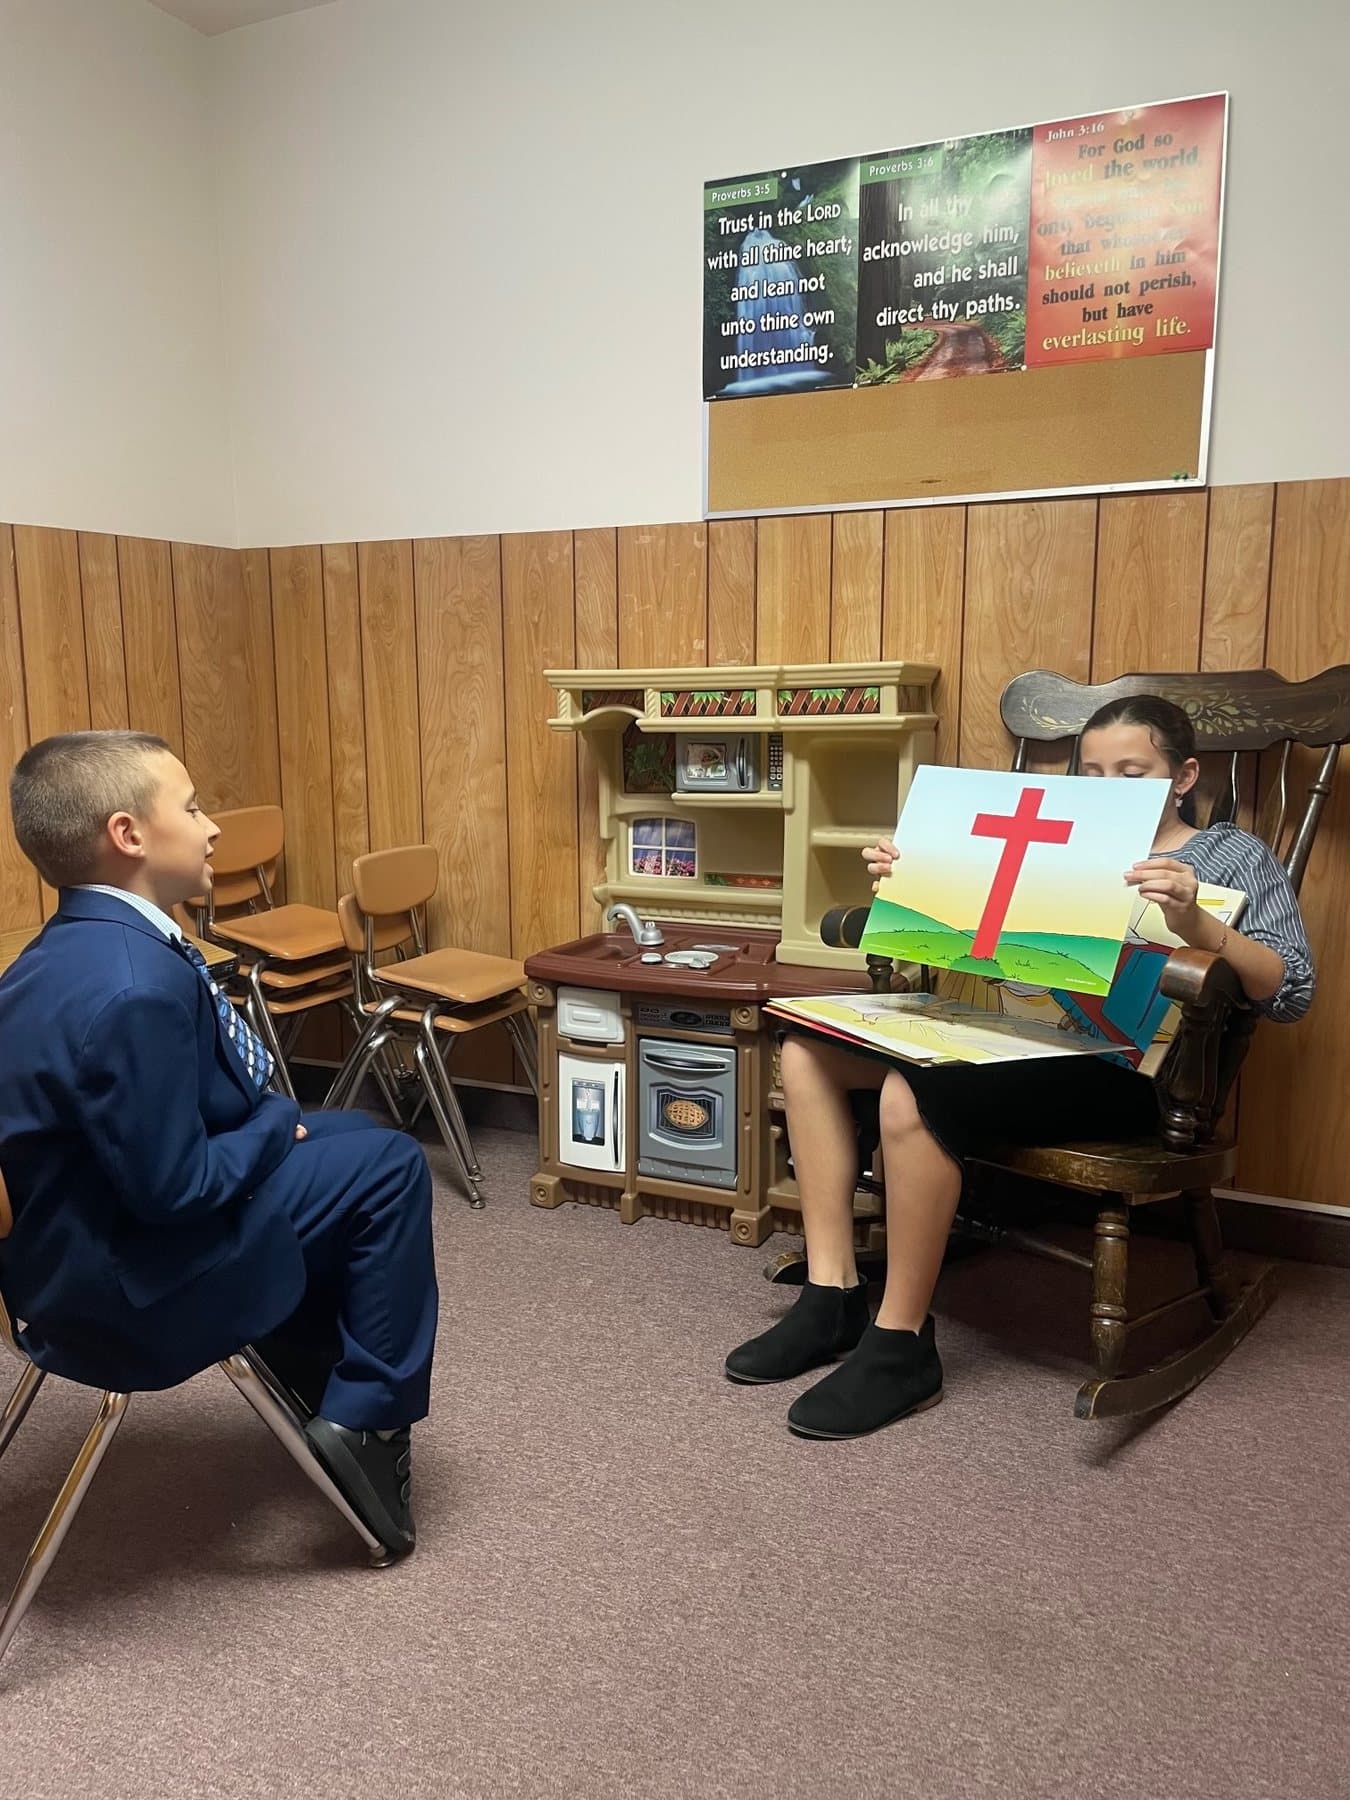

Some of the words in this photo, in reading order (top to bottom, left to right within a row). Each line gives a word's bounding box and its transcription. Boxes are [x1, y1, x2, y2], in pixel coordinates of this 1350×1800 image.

[1045, 128, 1074, 143] John
[1078, 121, 1105, 136] 3:16
[1078, 144, 1105, 160] For
[1113, 134, 1145, 153] God
[1154, 133, 1173, 147] so
[869, 159, 913, 177] Proverbs
[917, 156, 934, 169] 3:6
[1104, 159, 1134, 179] the
[1143, 146, 1199, 170] world
[712, 187, 751, 203] Proverbs
[754, 184, 770, 196] 3:5
[719, 213, 754, 235] Trust
[759, 211, 772, 229] in
[777, 207, 802, 226] the
[898, 203, 912, 222] In
[919, 197, 939, 218] all
[707, 248, 738, 270] with
[741, 246, 758, 266] all
[763, 242, 802, 263] thine
[806, 236, 852, 256] heart;
[863, 230, 974, 262] acknowledge
[983, 223, 1019, 244] him,
[1060, 240, 1090, 256] that
[913, 266, 945, 288] and
[951, 264, 972, 283] he
[978, 256, 1018, 279] shall
[1045, 257, 1121, 281] believeth
[1130, 256, 1146, 270] in
[1155, 250, 1186, 267] him
[730, 280, 758, 301] and
[763, 279, 794, 298] lean
[799, 273, 825, 293] not
[1042, 284, 1094, 305] should
[1104, 281, 1130, 296] not
[1140, 271, 1197, 296] perish,
[721, 318, 755, 337] unto
[760, 312, 799, 331] thine
[803, 309, 835, 327] own
[876, 304, 924, 327] direct
[932, 300, 959, 322] thy
[966, 292, 1020, 320] paths.
[1082, 307, 1108, 323] but
[1117, 302, 1154, 319] have
[1043, 325, 1144, 351] everlasting
[1156, 316, 1191, 337] life.
[720, 343, 834, 370] understanding.
